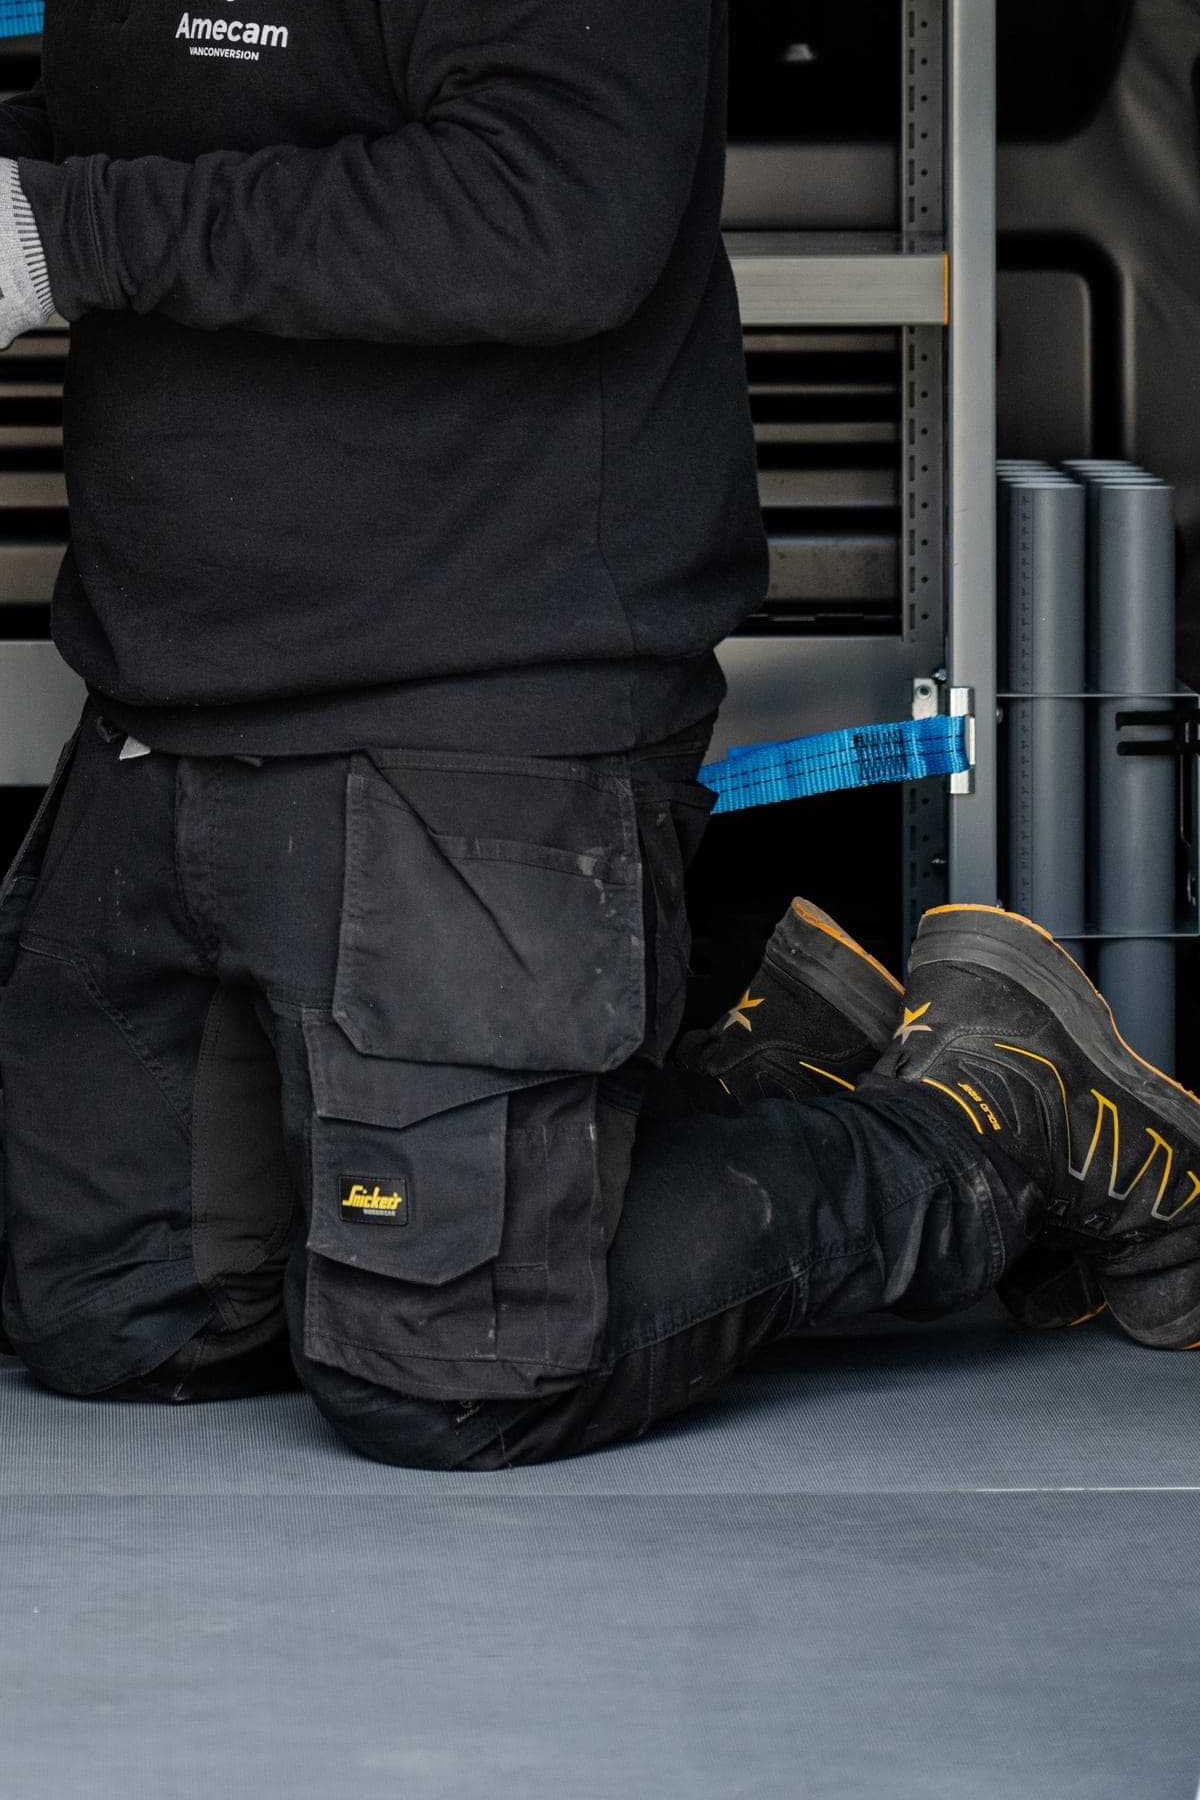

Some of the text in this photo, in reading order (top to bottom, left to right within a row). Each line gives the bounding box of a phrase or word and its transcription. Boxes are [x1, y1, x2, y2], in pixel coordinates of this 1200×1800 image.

[176, 12, 288, 48] Amecam
[189, 46, 259, 61] VANCONVERSION
[342, 1184, 403, 1210] Snickers
